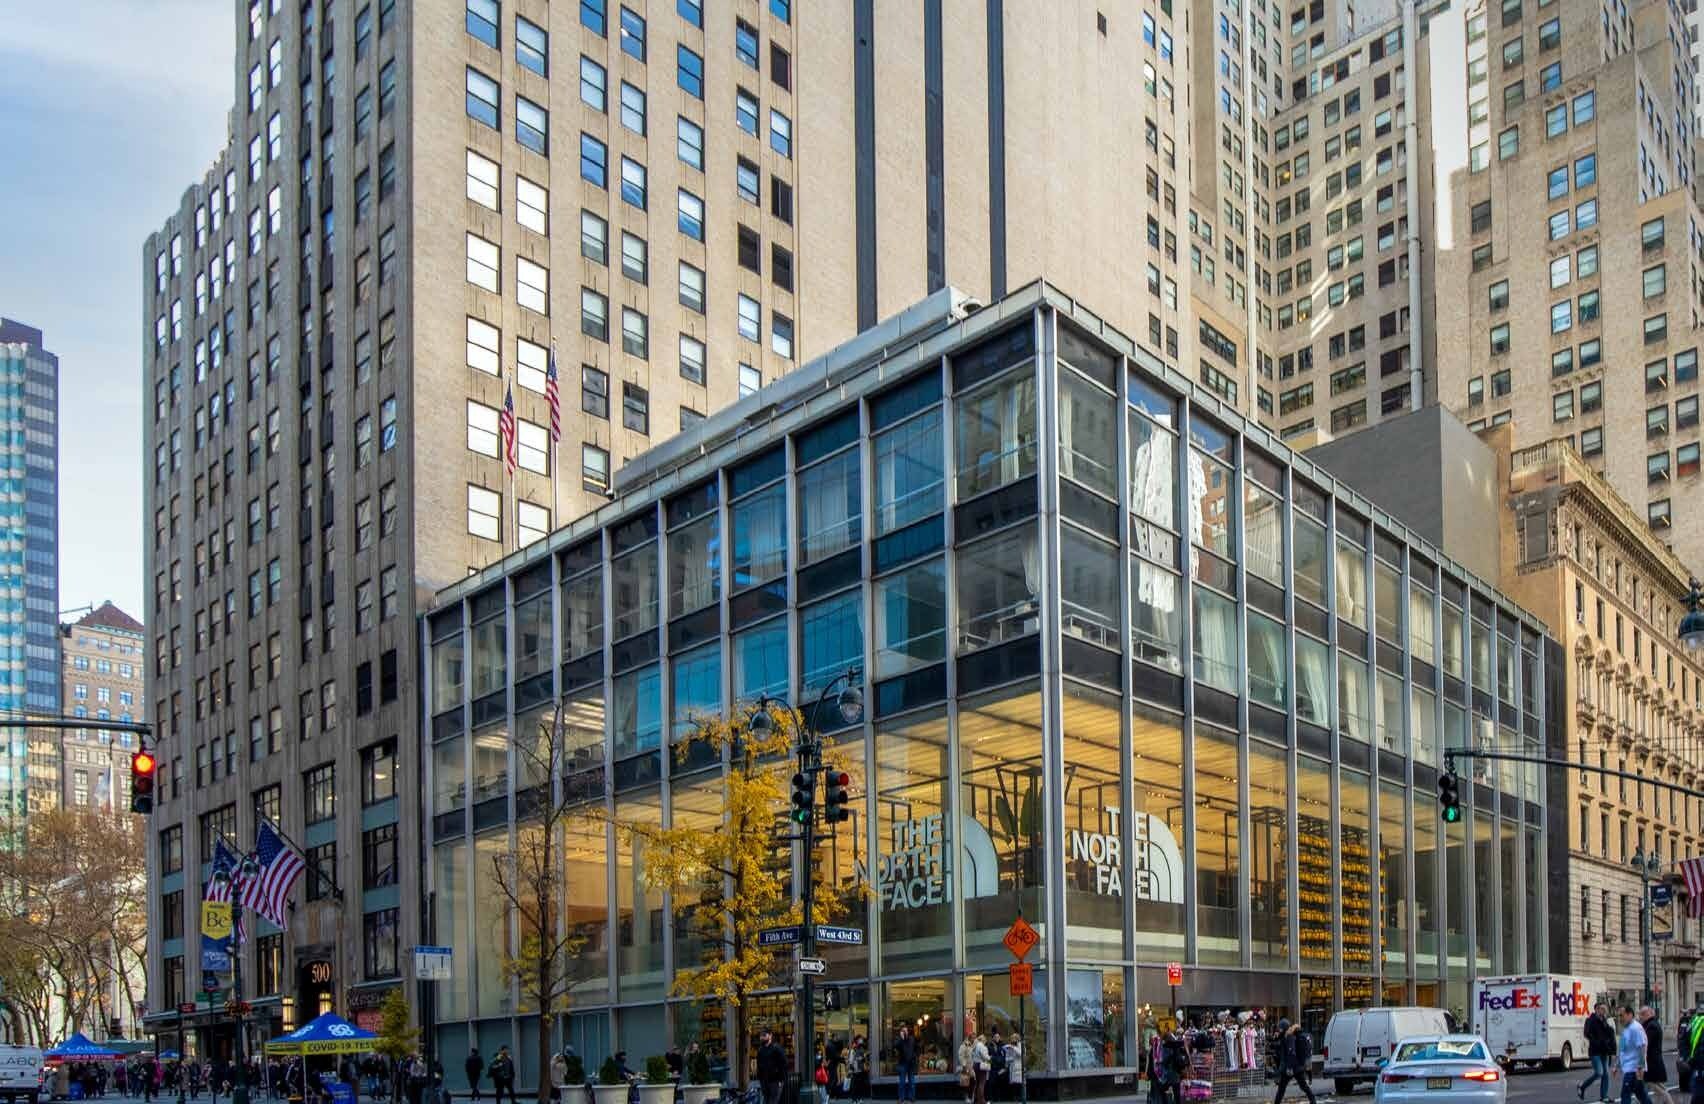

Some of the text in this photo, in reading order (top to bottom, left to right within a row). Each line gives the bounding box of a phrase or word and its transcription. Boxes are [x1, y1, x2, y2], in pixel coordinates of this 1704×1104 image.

[893, 813, 943, 851] THE
[1105, 805, 1148, 841] TE
[1072, 828, 1149, 872] NORH
[878, 876, 943, 912] FACE
[1096, 863, 1150, 901] FAE
[781, 931, 793, 941] Ave
[819, 928, 861, 942] West 43rd St
[311, 962, 330, 984] 500
[1479, 988, 1541, 1011] FedEx
[1552, 979, 1590, 1017] FedEx
